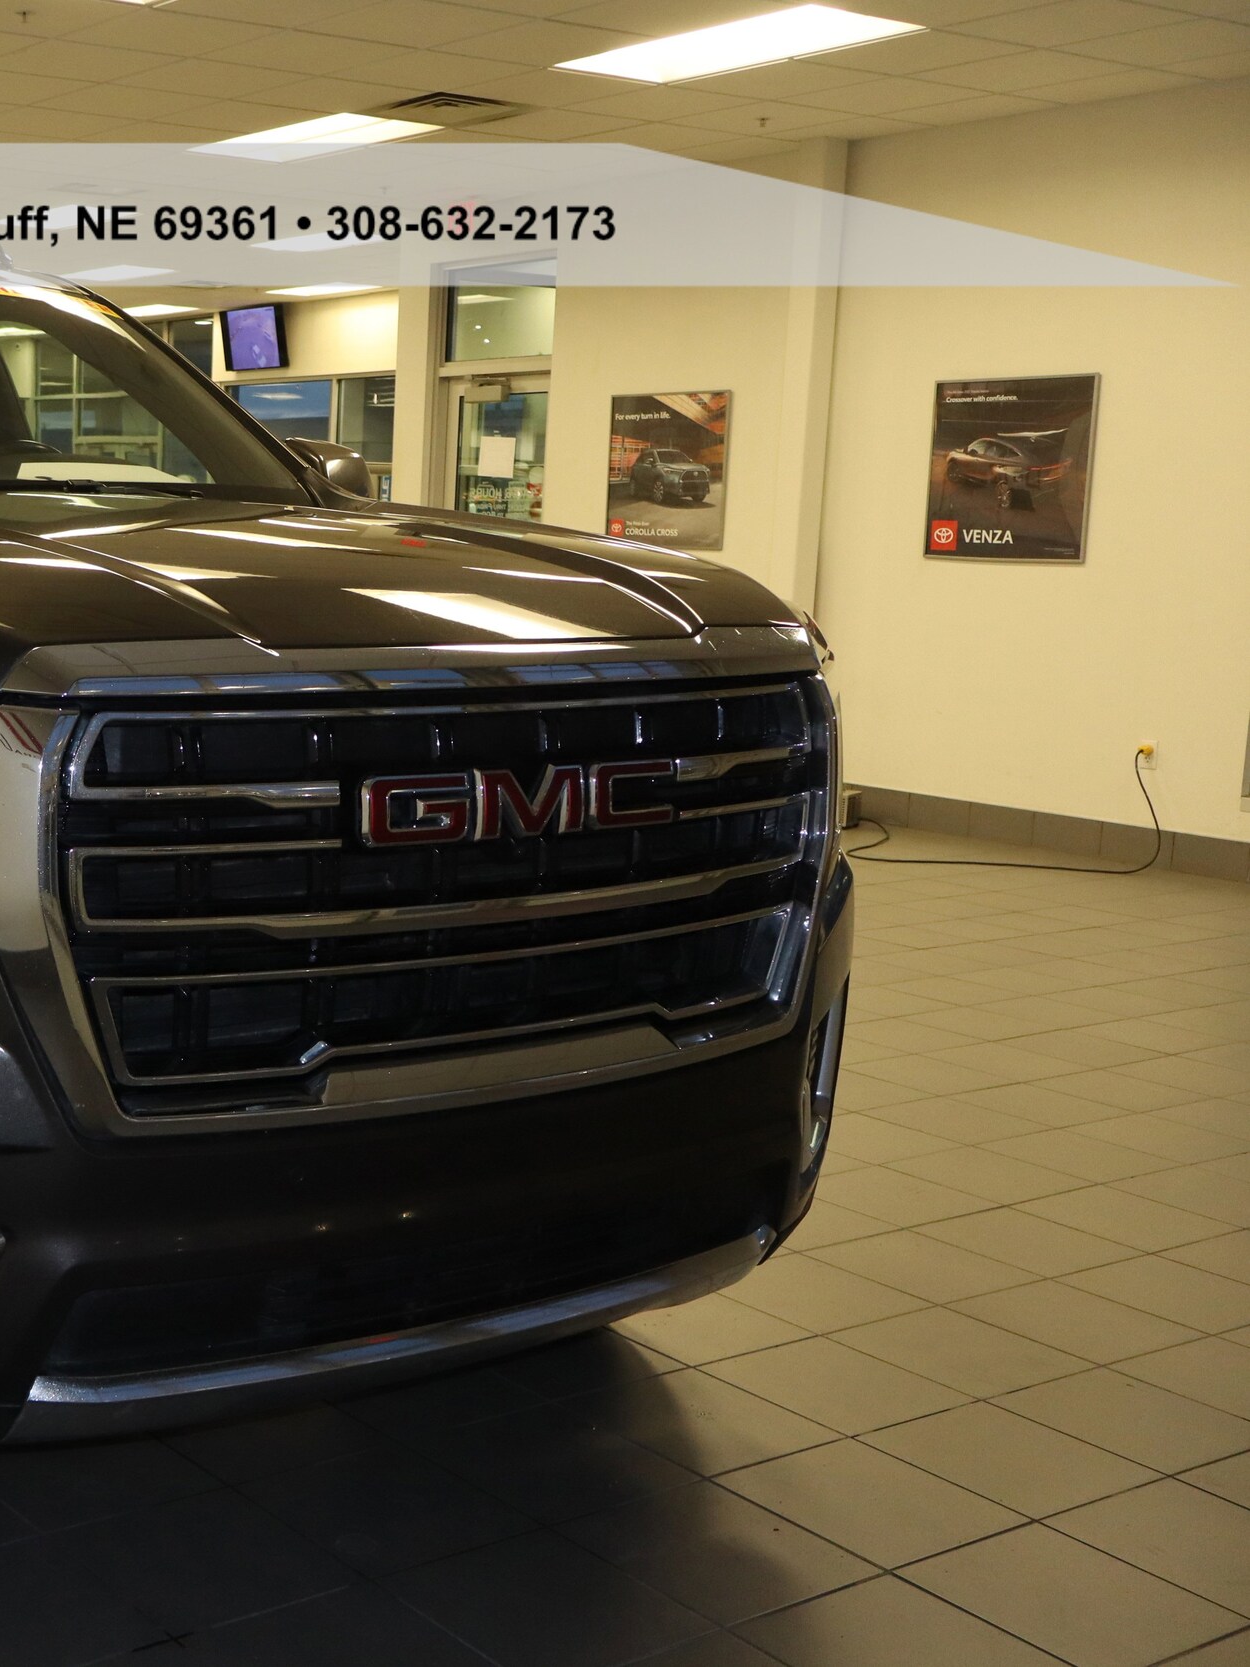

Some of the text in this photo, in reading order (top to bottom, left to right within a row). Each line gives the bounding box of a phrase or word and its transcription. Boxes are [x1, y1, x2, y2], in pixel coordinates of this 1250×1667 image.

[615, 413, 624, 421] For
[625, 413, 640, 422] every
[641, 412, 653, 420] turn
[653, 411, 660, 419] in
[624, 527, 679, 537] COROLLA CROSS
[962, 529, 1014, 545] VENZA
[361, 759, 674, 847] GMC
